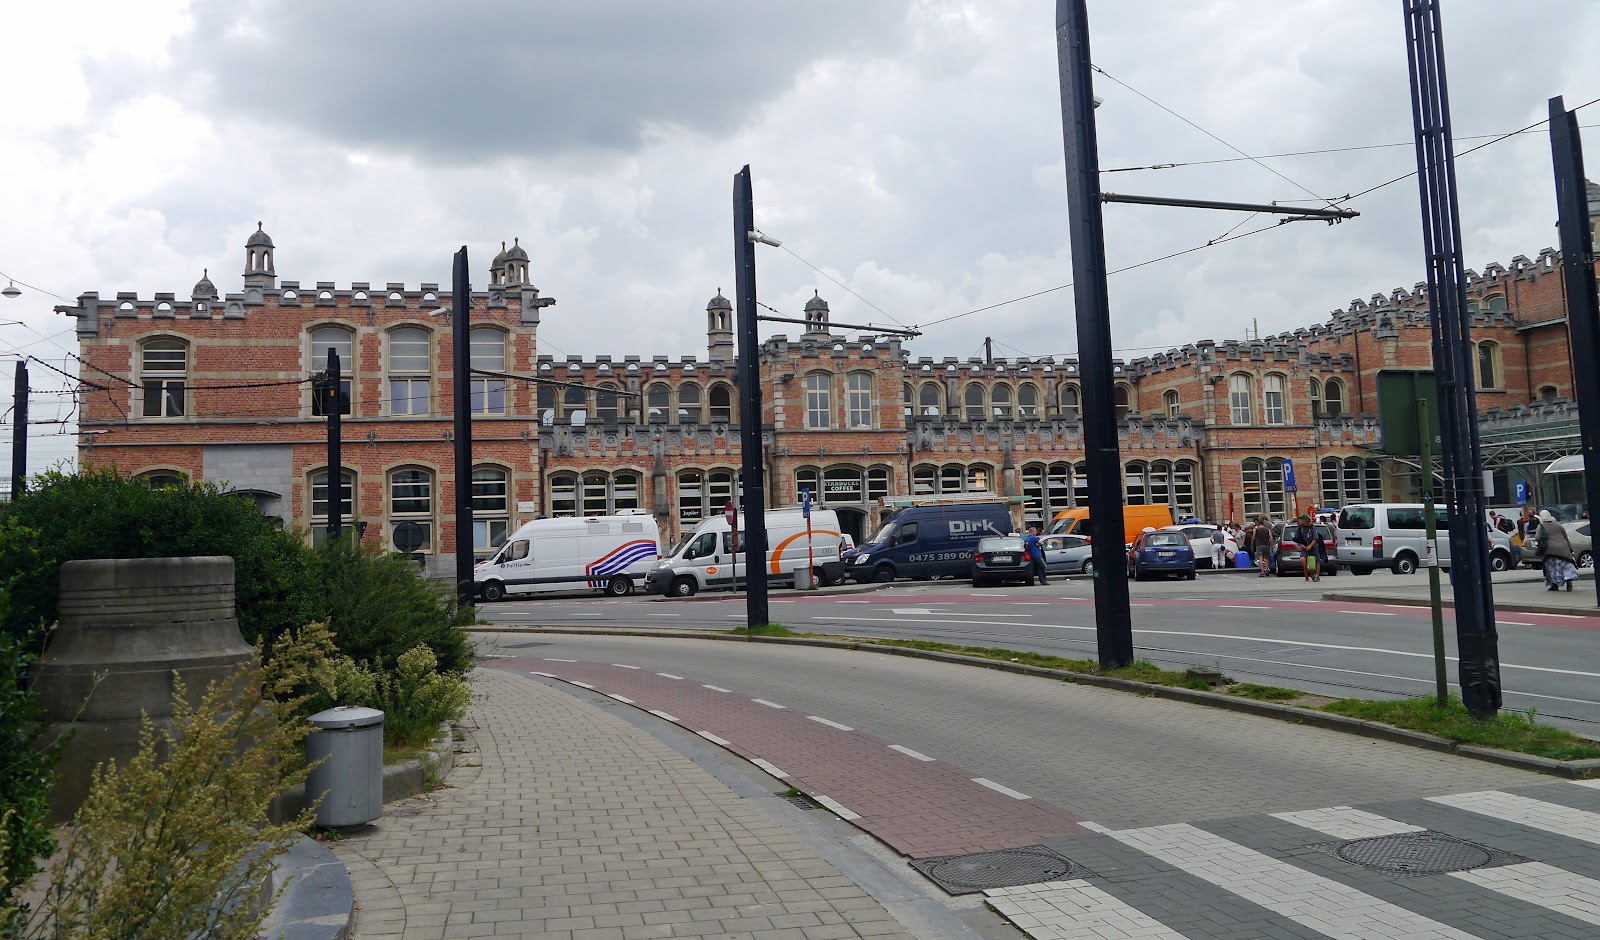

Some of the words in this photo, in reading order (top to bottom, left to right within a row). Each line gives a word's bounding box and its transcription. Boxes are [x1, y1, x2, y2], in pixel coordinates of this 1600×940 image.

[1284, 463, 1291, 480] P
[1516, 484, 1523, 497] P
[949, 519, 1004, 539] Dirk
[909, 553, 935, 562] 0475
[937, 552, 956, 561] 389
